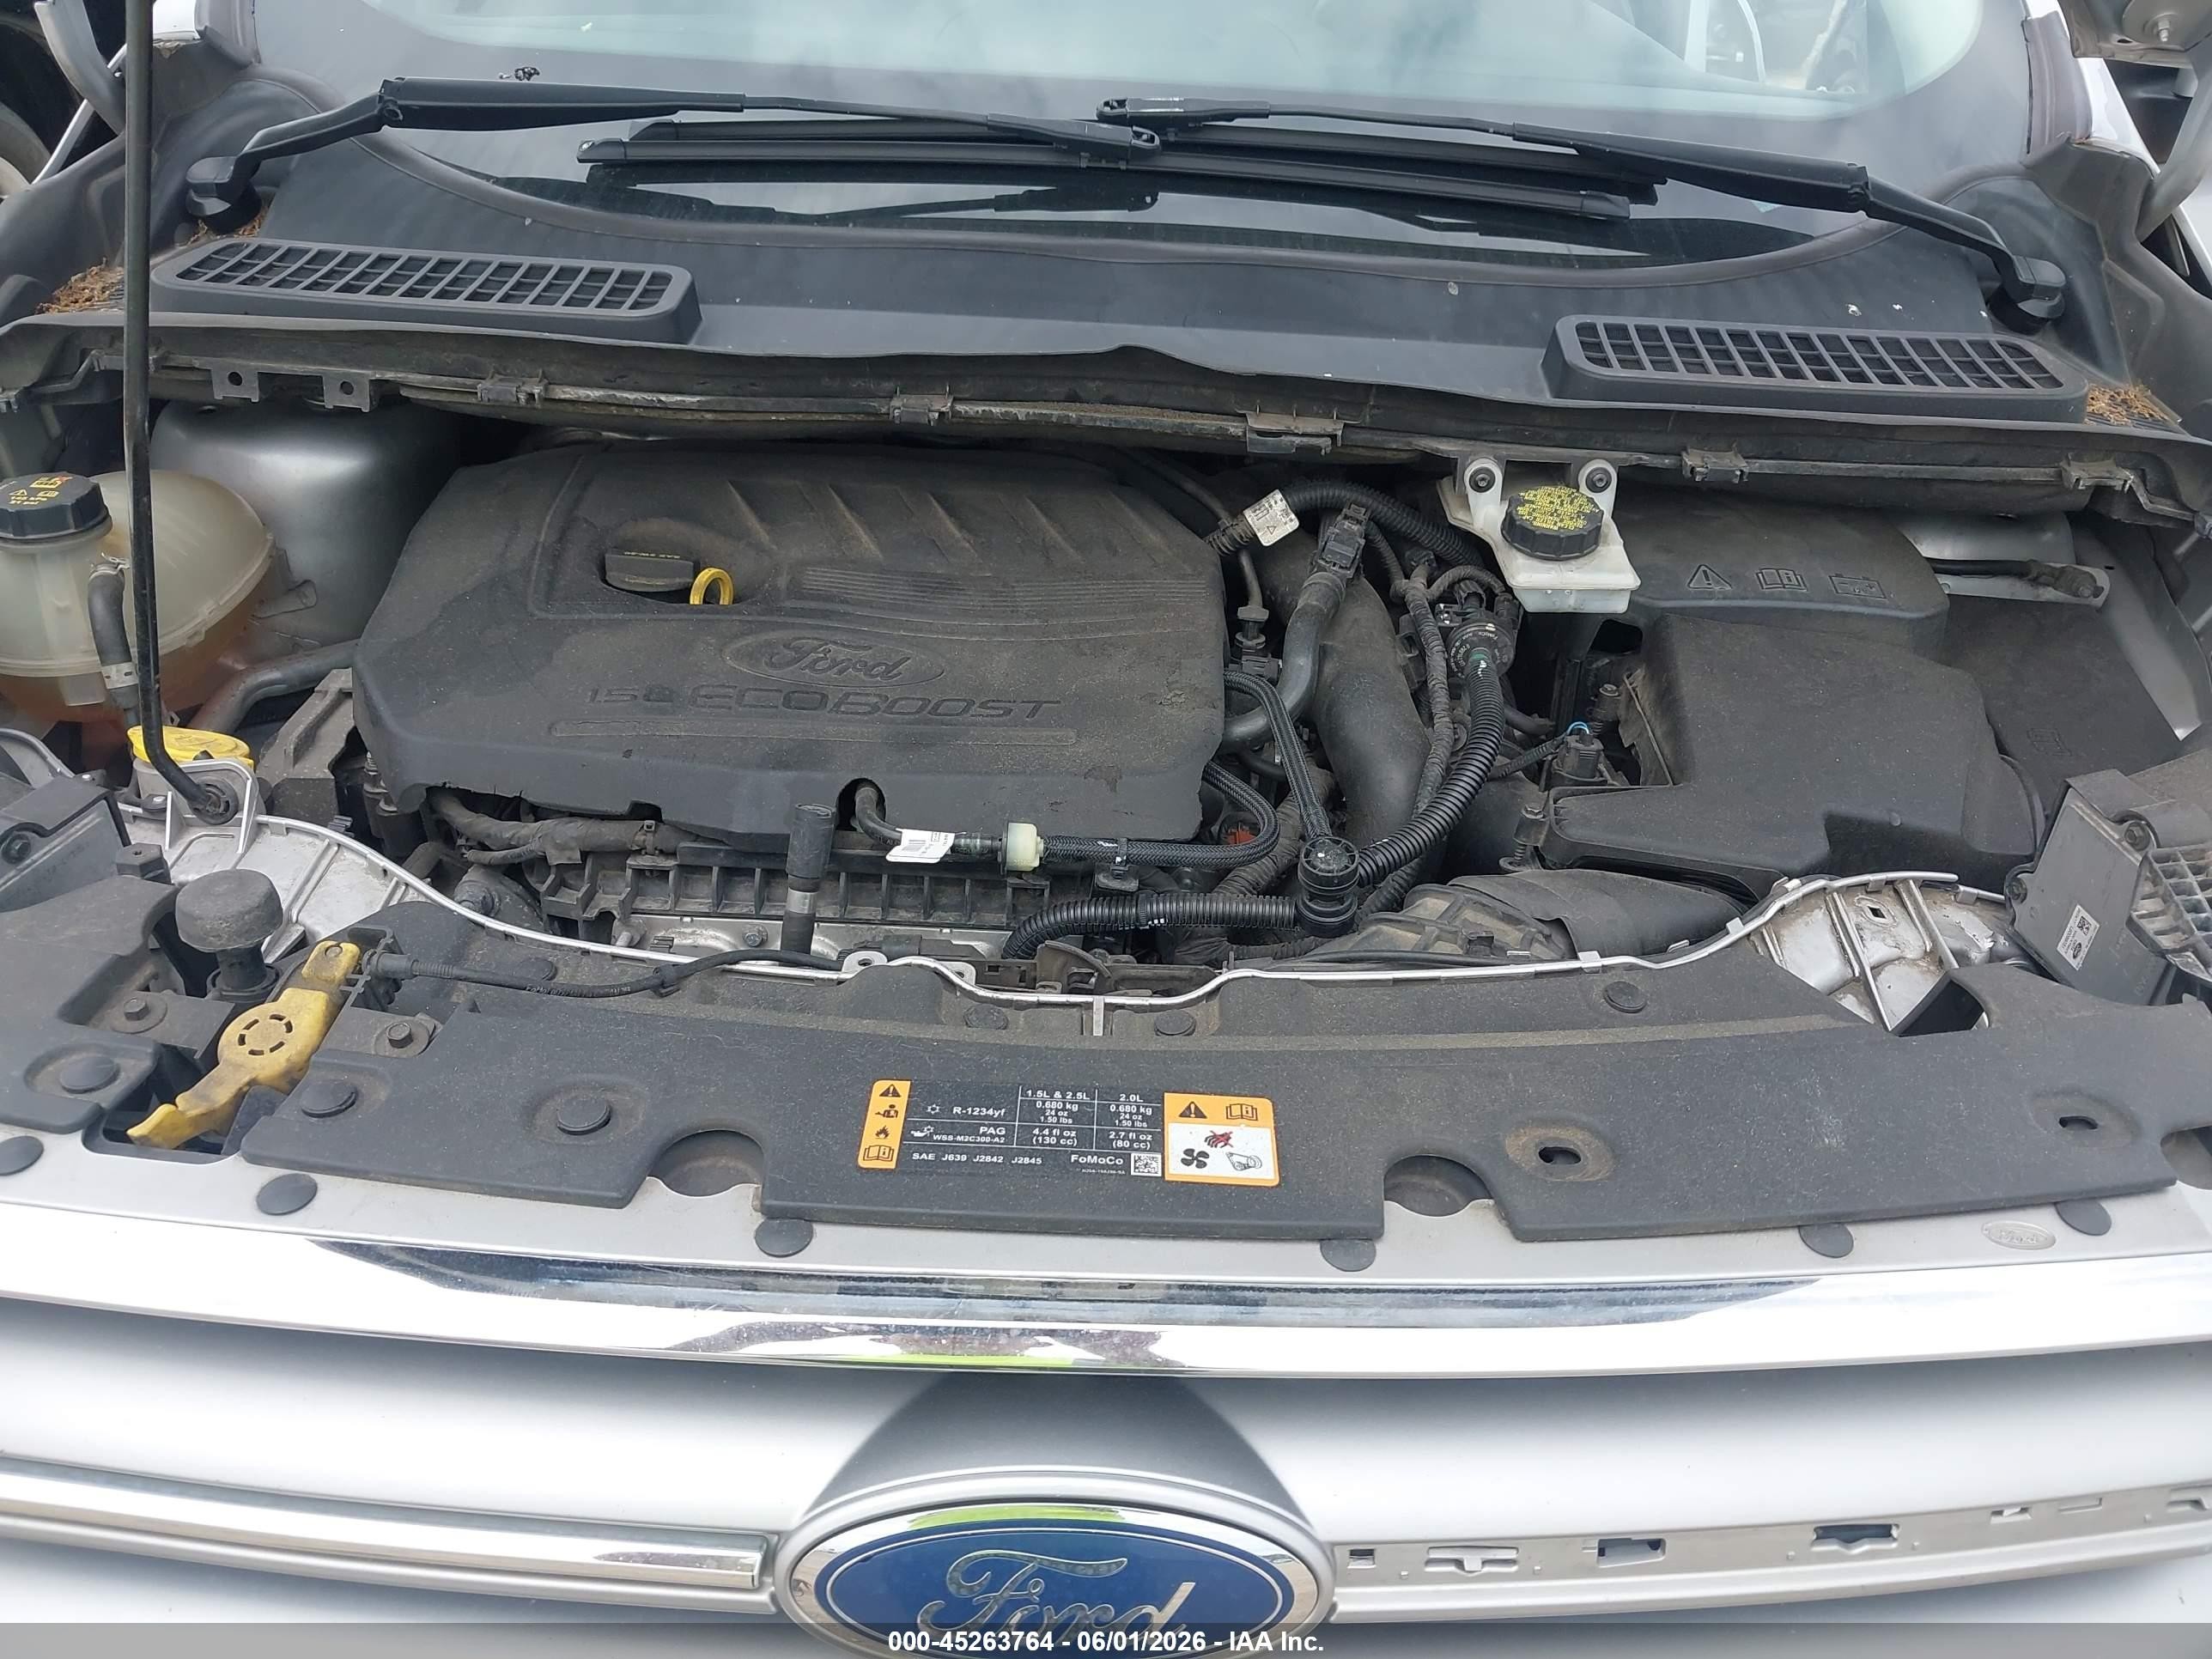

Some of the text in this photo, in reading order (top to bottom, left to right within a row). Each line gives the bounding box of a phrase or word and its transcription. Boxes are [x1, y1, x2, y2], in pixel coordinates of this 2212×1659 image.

[763, 637, 911, 680] Ford
[1026, 1090, 1050, 1098] 1.5L
[1066, 1091, 1091, 1100] 2.5L
[1119, 1094, 1144, 1103] 2.0L
[952, 1106, 1006, 1117] R-1234yf
[1066, 1103, 1079, 1111] kg
[1109, 1104, 1152, 1115] 0.680 kg
[979, 1126, 1006, 1136] PAG
[1032, 1136, 1078, 1147] (130 cc)
[1112, 1139, 1151, 1150] (80 cc)
[912, 1152, 1042, 1165] SAE J639 J2842 J2845
[1071, 1154, 1124, 1166] FoMoCo
[1997, 1229, 2038, 1245] Ford
[917, 1550, 1196, 1640] Ford
